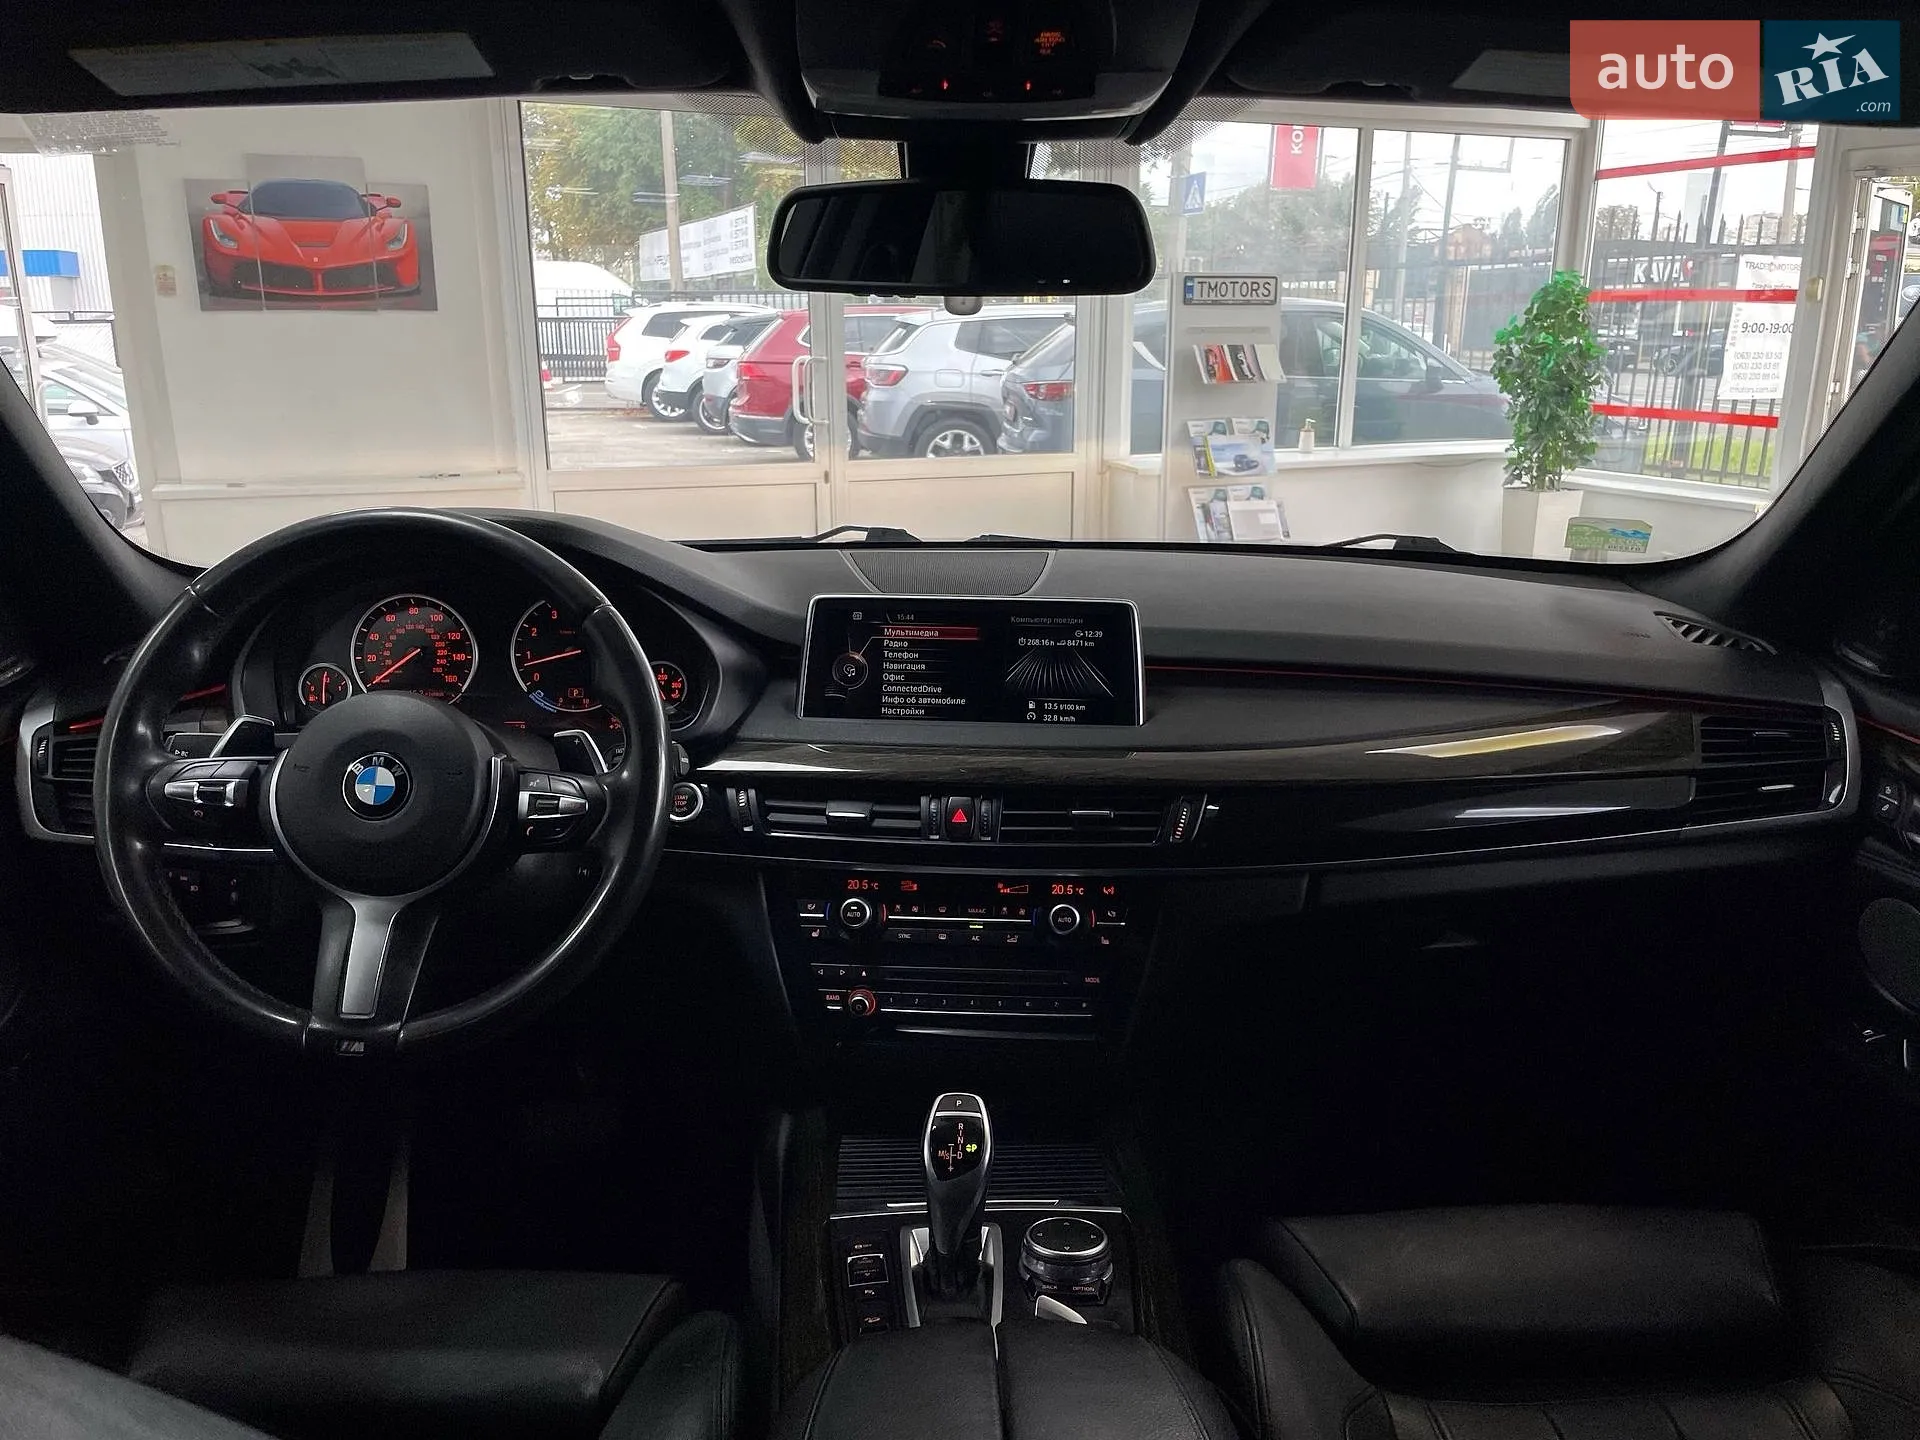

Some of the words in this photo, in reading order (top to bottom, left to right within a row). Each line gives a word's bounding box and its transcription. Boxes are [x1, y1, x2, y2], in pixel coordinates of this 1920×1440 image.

[1198, 281, 1272, 298] TMOTORS
[408, 607, 419, 615] 80
[551, 610, 558, 619] 3
[385, 614, 396, 622] 60
[430, 614, 444, 622] 100
[447, 632, 461, 640] 120
[531, 628, 537, 636] 2
[884, 628, 939, 638] Мультимедиа
[1084, 630, 1103, 638] 12:39
[370, 633, 379, 641] 40
[883, 639, 909, 648] Радио
[1027, 638, 1050, 646] 268:16
[1067, 639, 1083, 647] 8471
[452, 653, 466, 661] 140
[526, 651, 531, 659] 1
[883, 650, 919, 660] Телефон
[883, 662, 926, 671] Навигация
[444, 675, 458, 683] 160
[533, 673, 540, 681] 0
[883, 673, 905, 682] Офис
[882, 684, 942, 693] ConnectedDrive
[882, 695, 905, 704] Инфо
[906, 696, 916, 704] об
[918, 697, 966, 705] автомобиле
[1044, 702, 1058, 710] 13.5
[881, 706, 925, 715] Настройки
[1043, 714, 1058, 722] 32.8
[351, 756, 405, 777] BMW
[1051, 884, 1073, 895] 20.5
[957, 1136, 964, 1144] N
[957, 1152, 963, 1160] D
